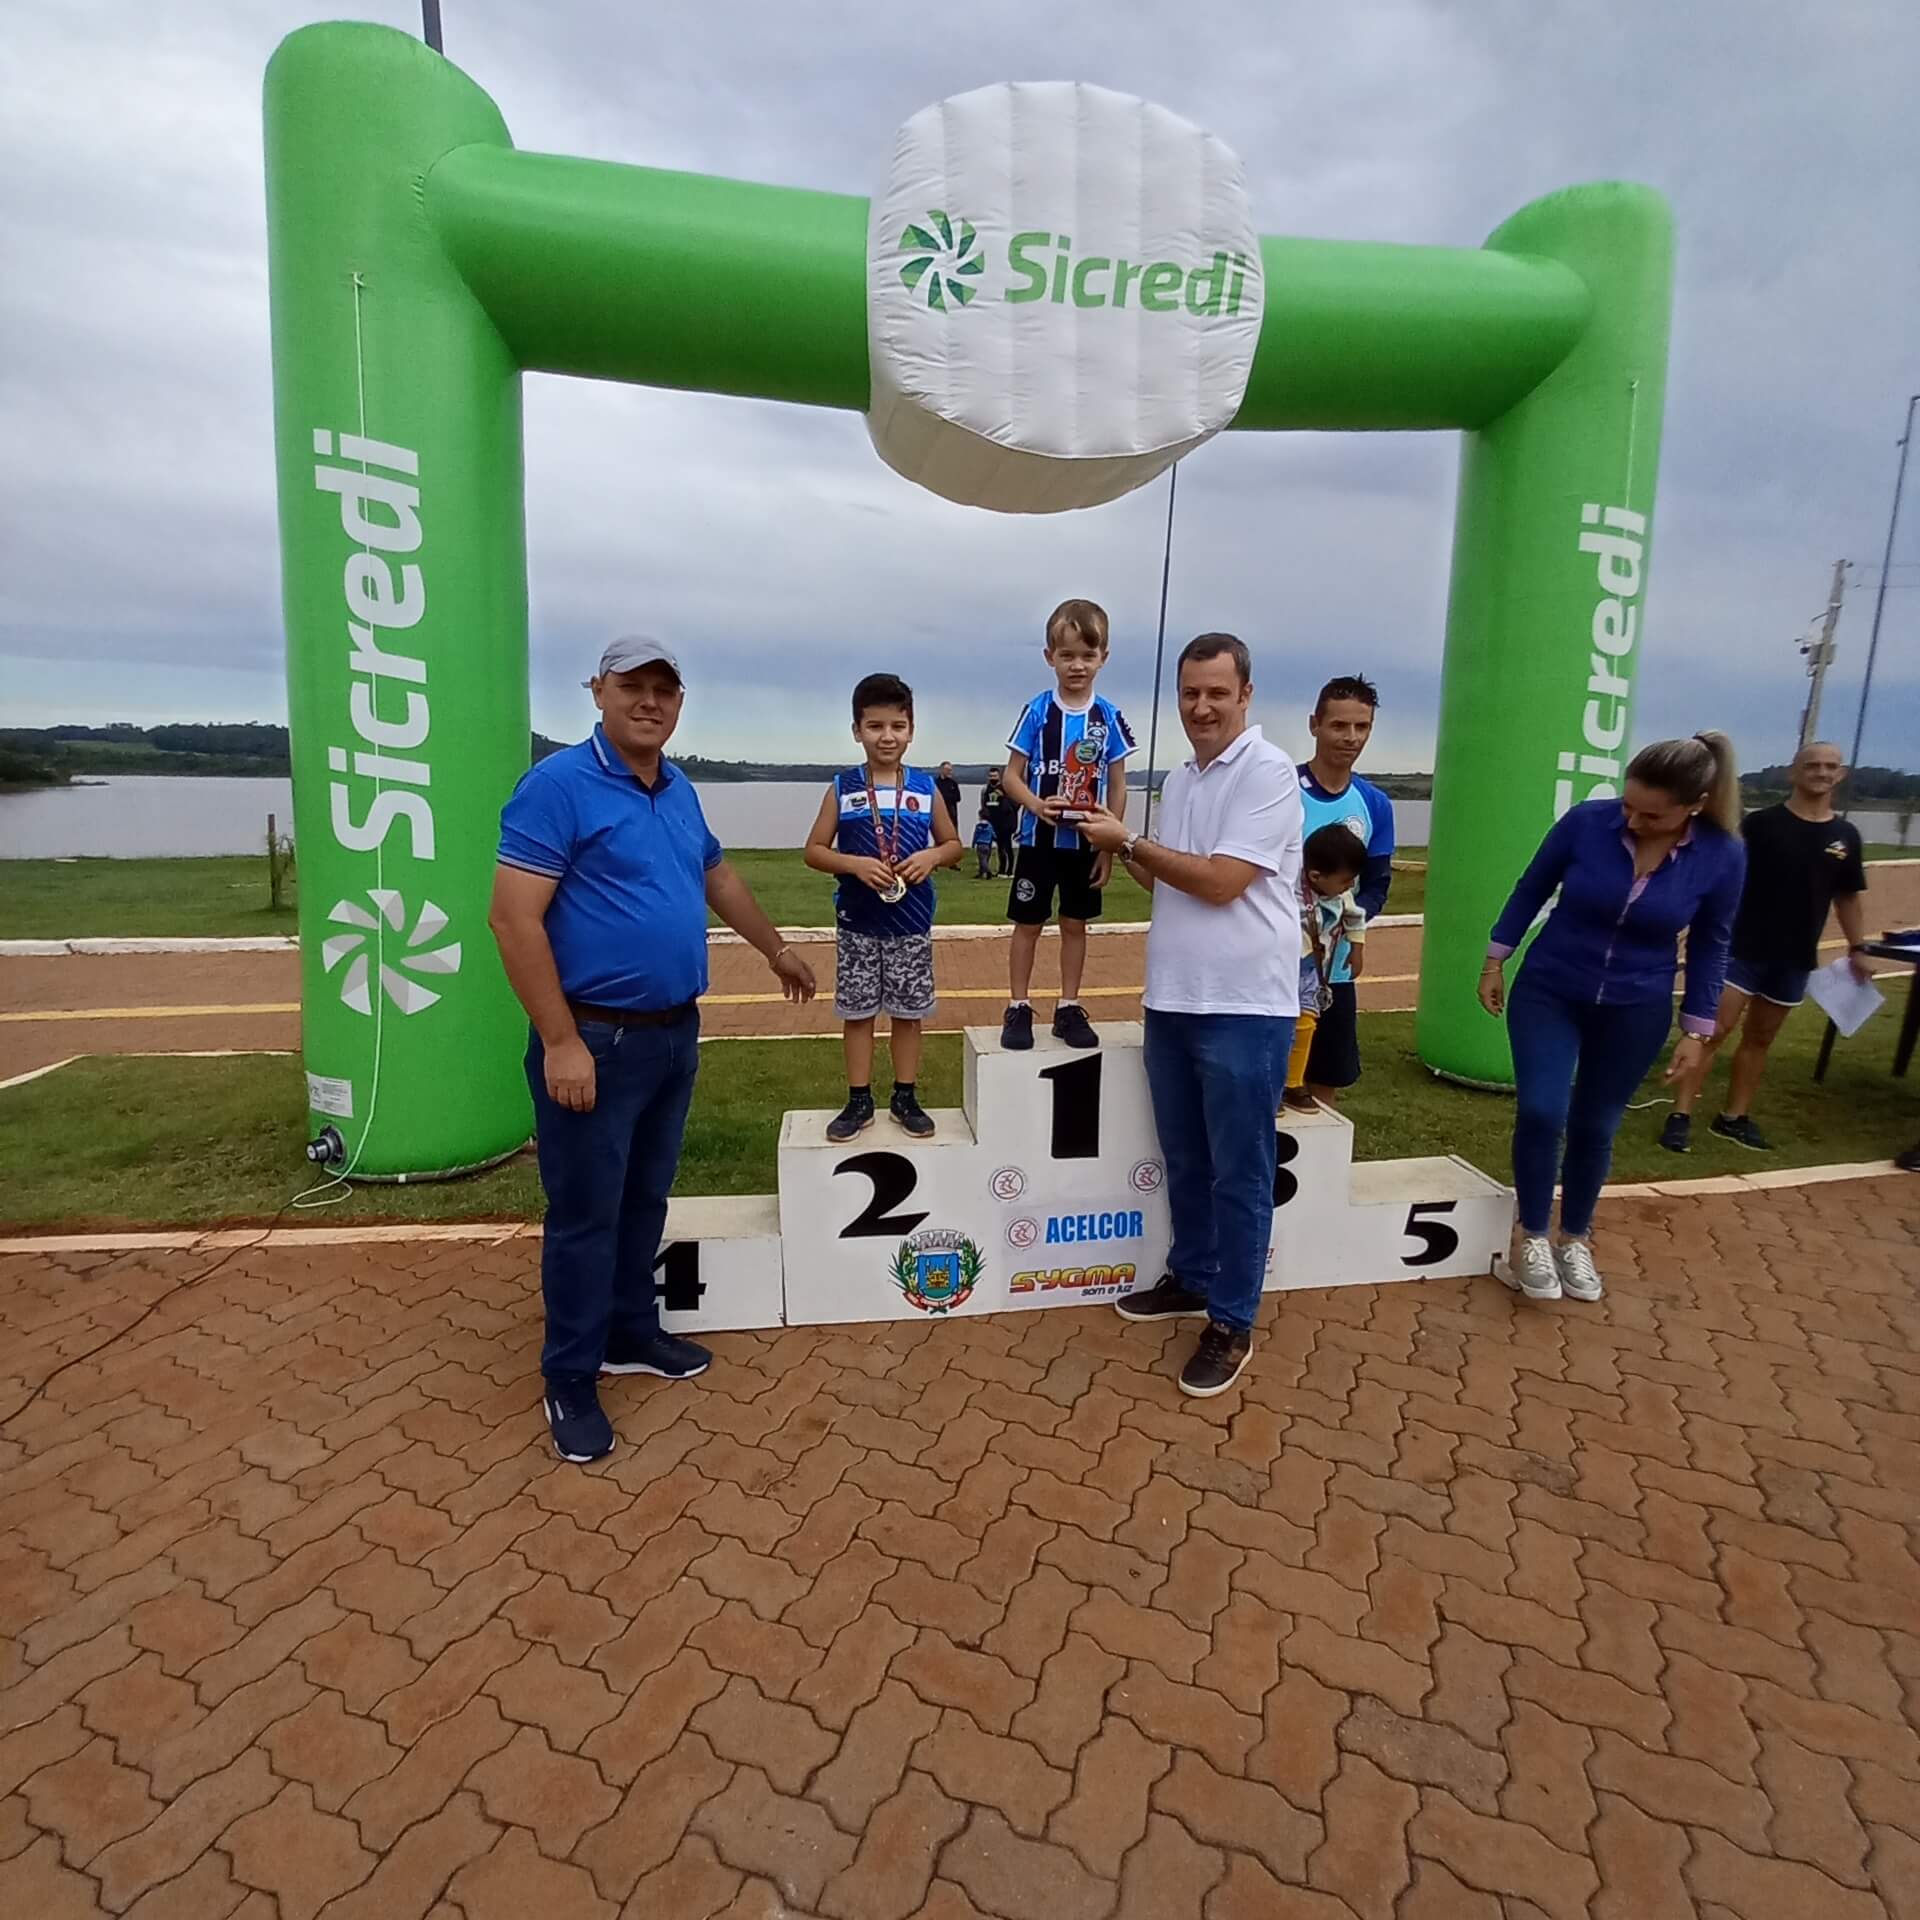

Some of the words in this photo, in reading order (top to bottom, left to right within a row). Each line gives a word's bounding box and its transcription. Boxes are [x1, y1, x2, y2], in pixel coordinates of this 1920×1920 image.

[1004, 231, 1247, 317] Sicredi
[312, 428, 436, 861] Sicredi
[1039, 1052, 1102, 1159] 1
[832, 1151, 931, 1238] 2
[1045, 1210, 1143, 1244] ACELCOR
[1401, 1200, 1459, 1266] 5
[651, 1241, 708, 1311] 4
[1009, 1263, 1137, 1294] SYGMA
[1081, 1286, 1106, 1297] som
